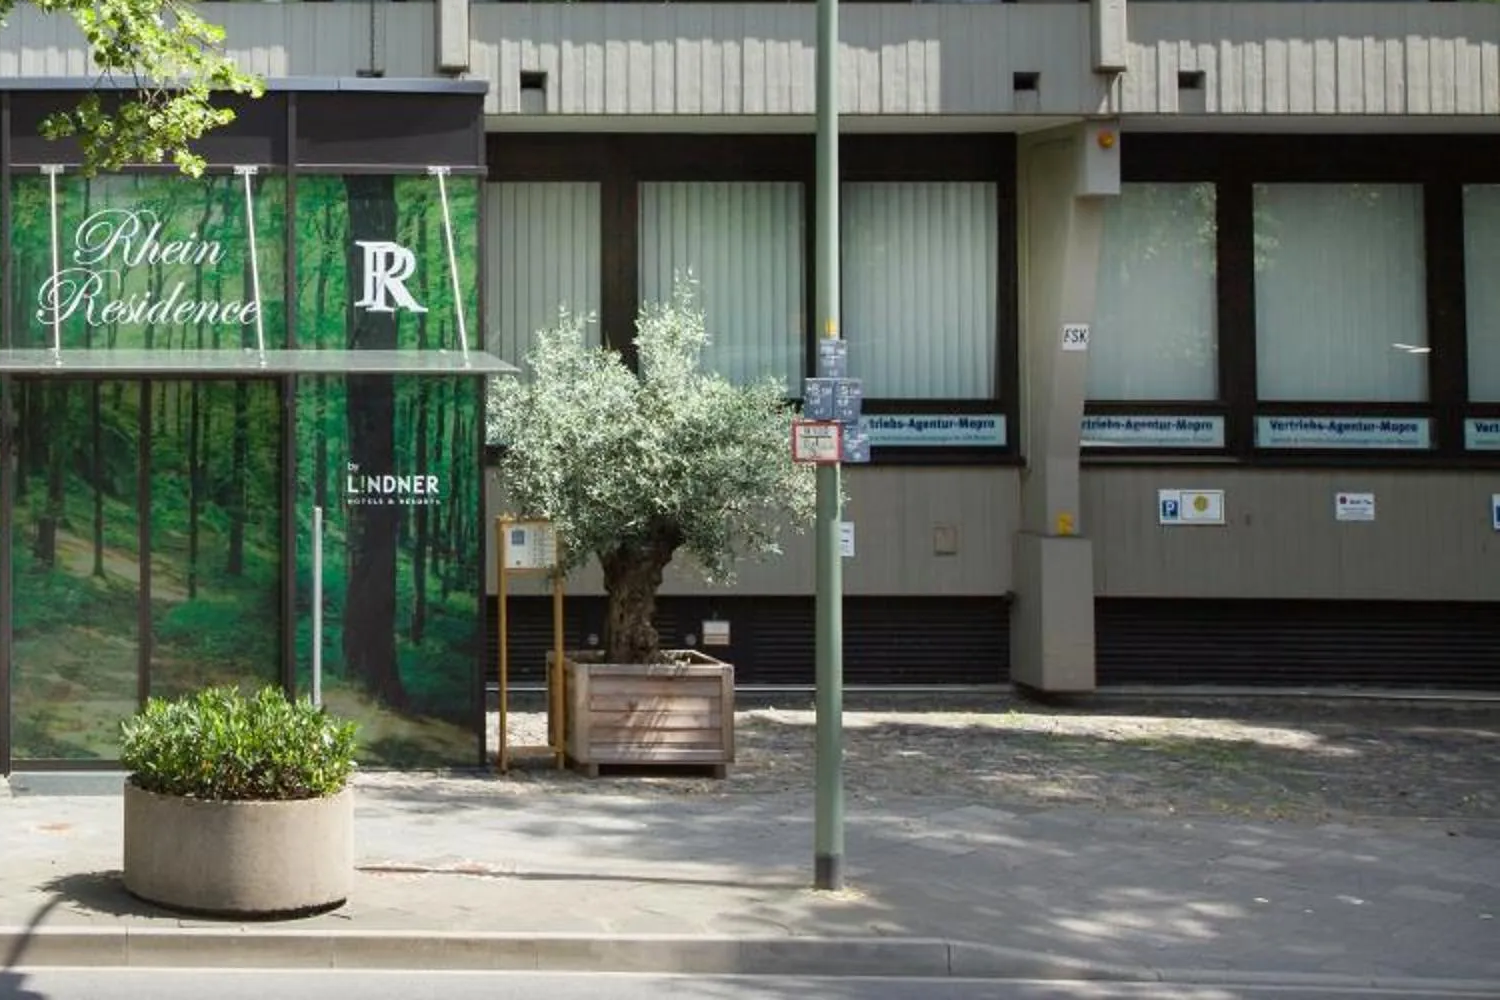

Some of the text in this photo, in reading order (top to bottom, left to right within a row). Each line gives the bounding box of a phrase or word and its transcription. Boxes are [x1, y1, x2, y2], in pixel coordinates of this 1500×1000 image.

[73, 208, 227, 267] Rhein
[35, 267, 260, 327] Residence
[347, 462, 360, 473] by
